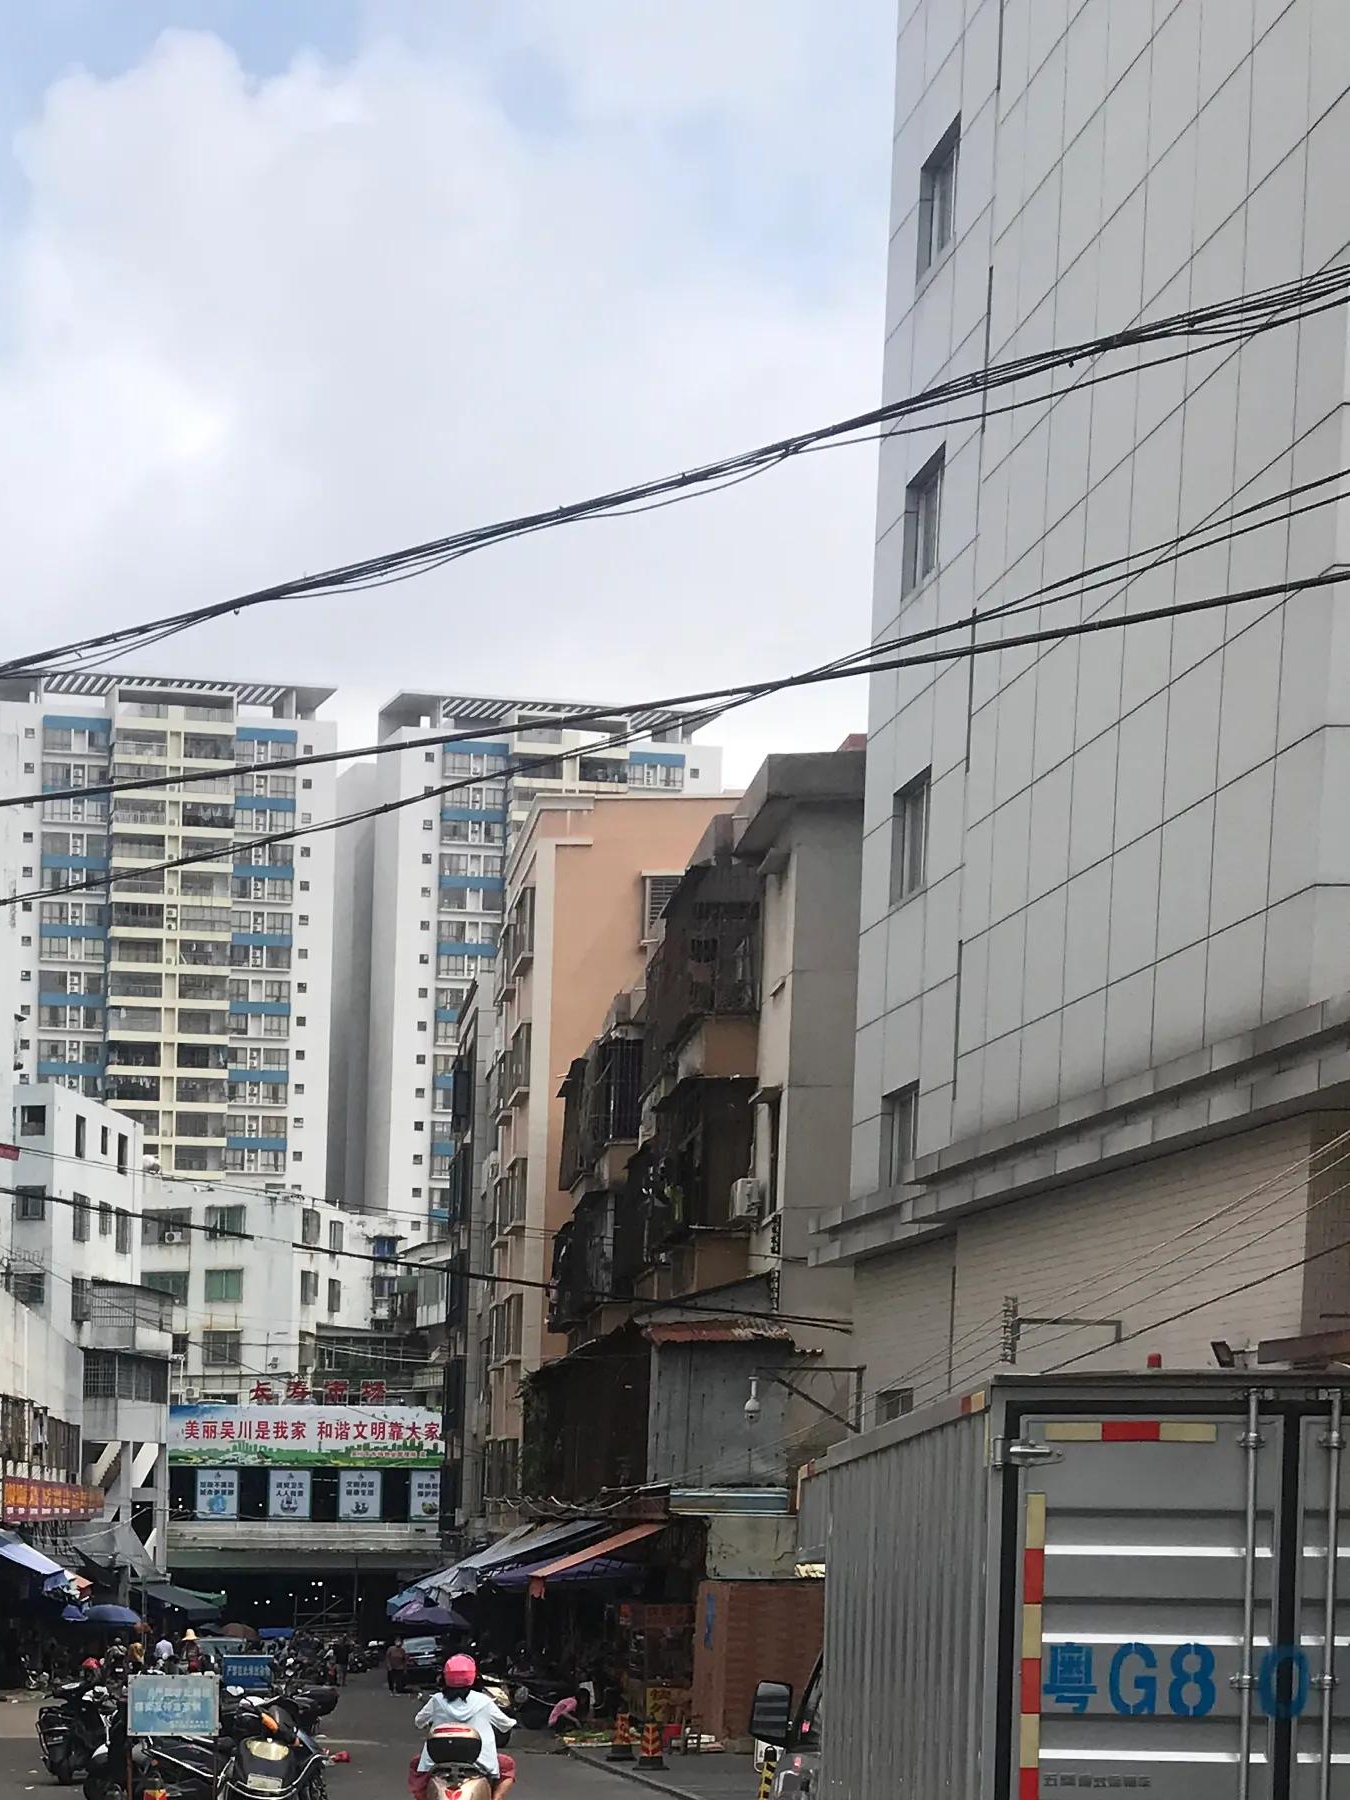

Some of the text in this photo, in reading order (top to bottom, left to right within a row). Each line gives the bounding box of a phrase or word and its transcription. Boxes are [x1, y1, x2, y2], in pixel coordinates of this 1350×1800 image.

[184, 1420, 440, 1442] 美丽吴川是我家 和谐文明靠大家
